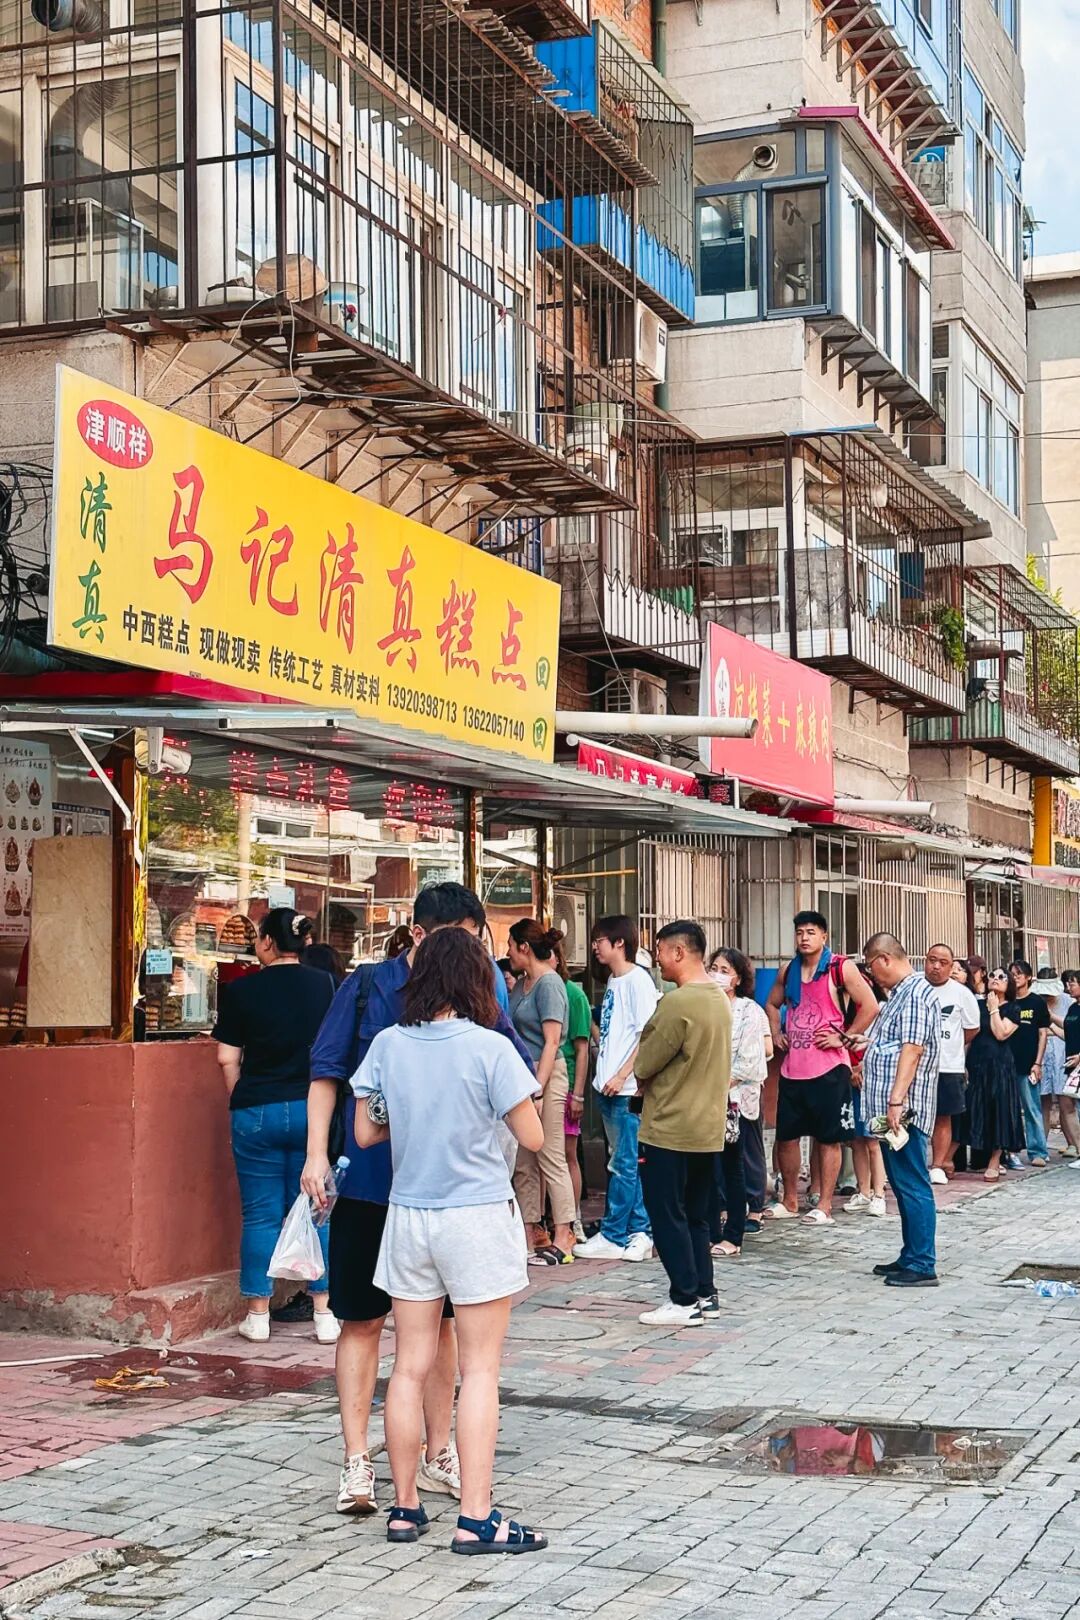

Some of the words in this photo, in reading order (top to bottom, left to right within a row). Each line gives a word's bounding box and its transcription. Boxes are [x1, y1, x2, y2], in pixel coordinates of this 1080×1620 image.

[85, 407, 148, 464] 津顺祥
[72, 471, 113, 645] 清真
[153, 464, 527, 692] 马记清真糕点
[122, 604, 190, 656] 中西糕点
[200, 626, 261, 675] 现做现卖
[268, 645, 324, 692] 传统工艺
[330, 663, 380, 706] 真材实料
[386, 683, 457, 724] 13920398713
[462, 705, 525, 742] 13622057140
